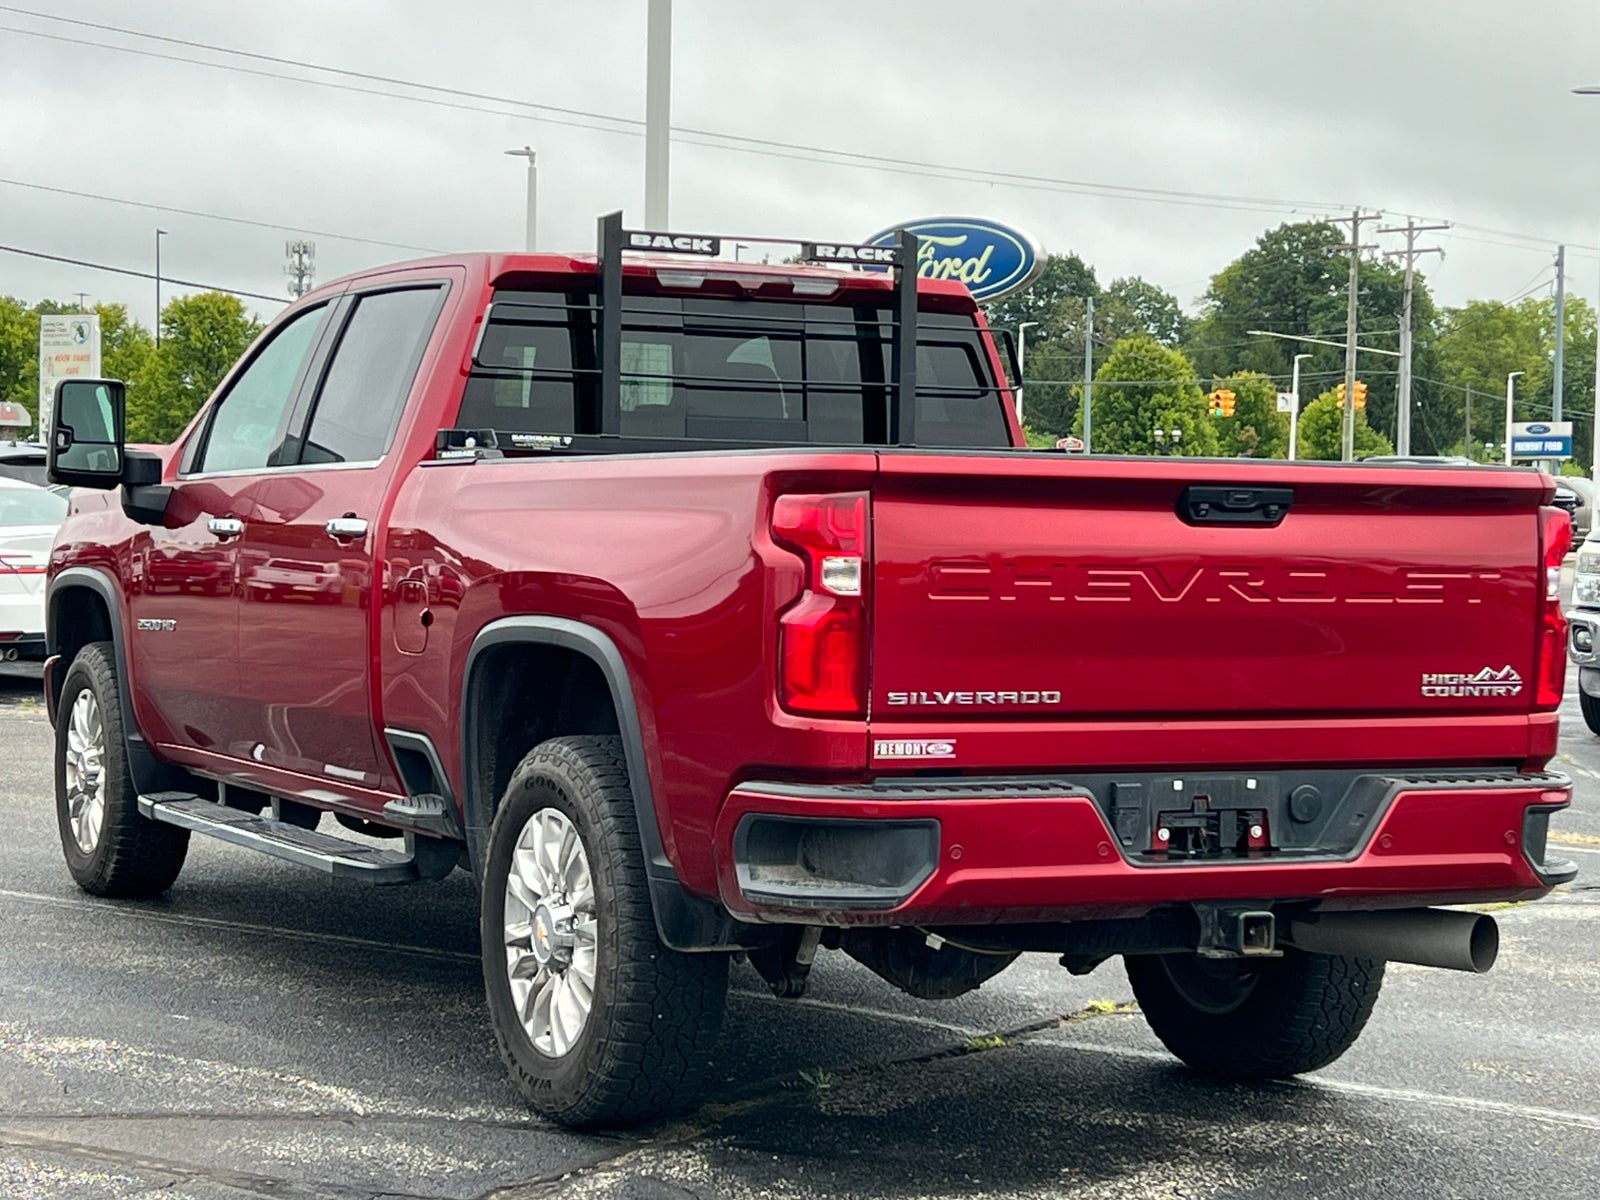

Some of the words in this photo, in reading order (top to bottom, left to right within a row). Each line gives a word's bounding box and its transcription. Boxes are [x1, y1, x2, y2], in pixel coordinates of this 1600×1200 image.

[630, 233, 712, 252] BACK
[816, 244, 895, 262] RACK
[915, 234, 995, 284] Ford
[928, 561, 1502, 604] CHEVROLET
[1422, 673, 1475, 684] HIGH
[887, 690, 1062, 705] SILVERADO
[1421, 685, 1522, 697] COUNTRY
[874, 743, 928, 755] FREMONT
